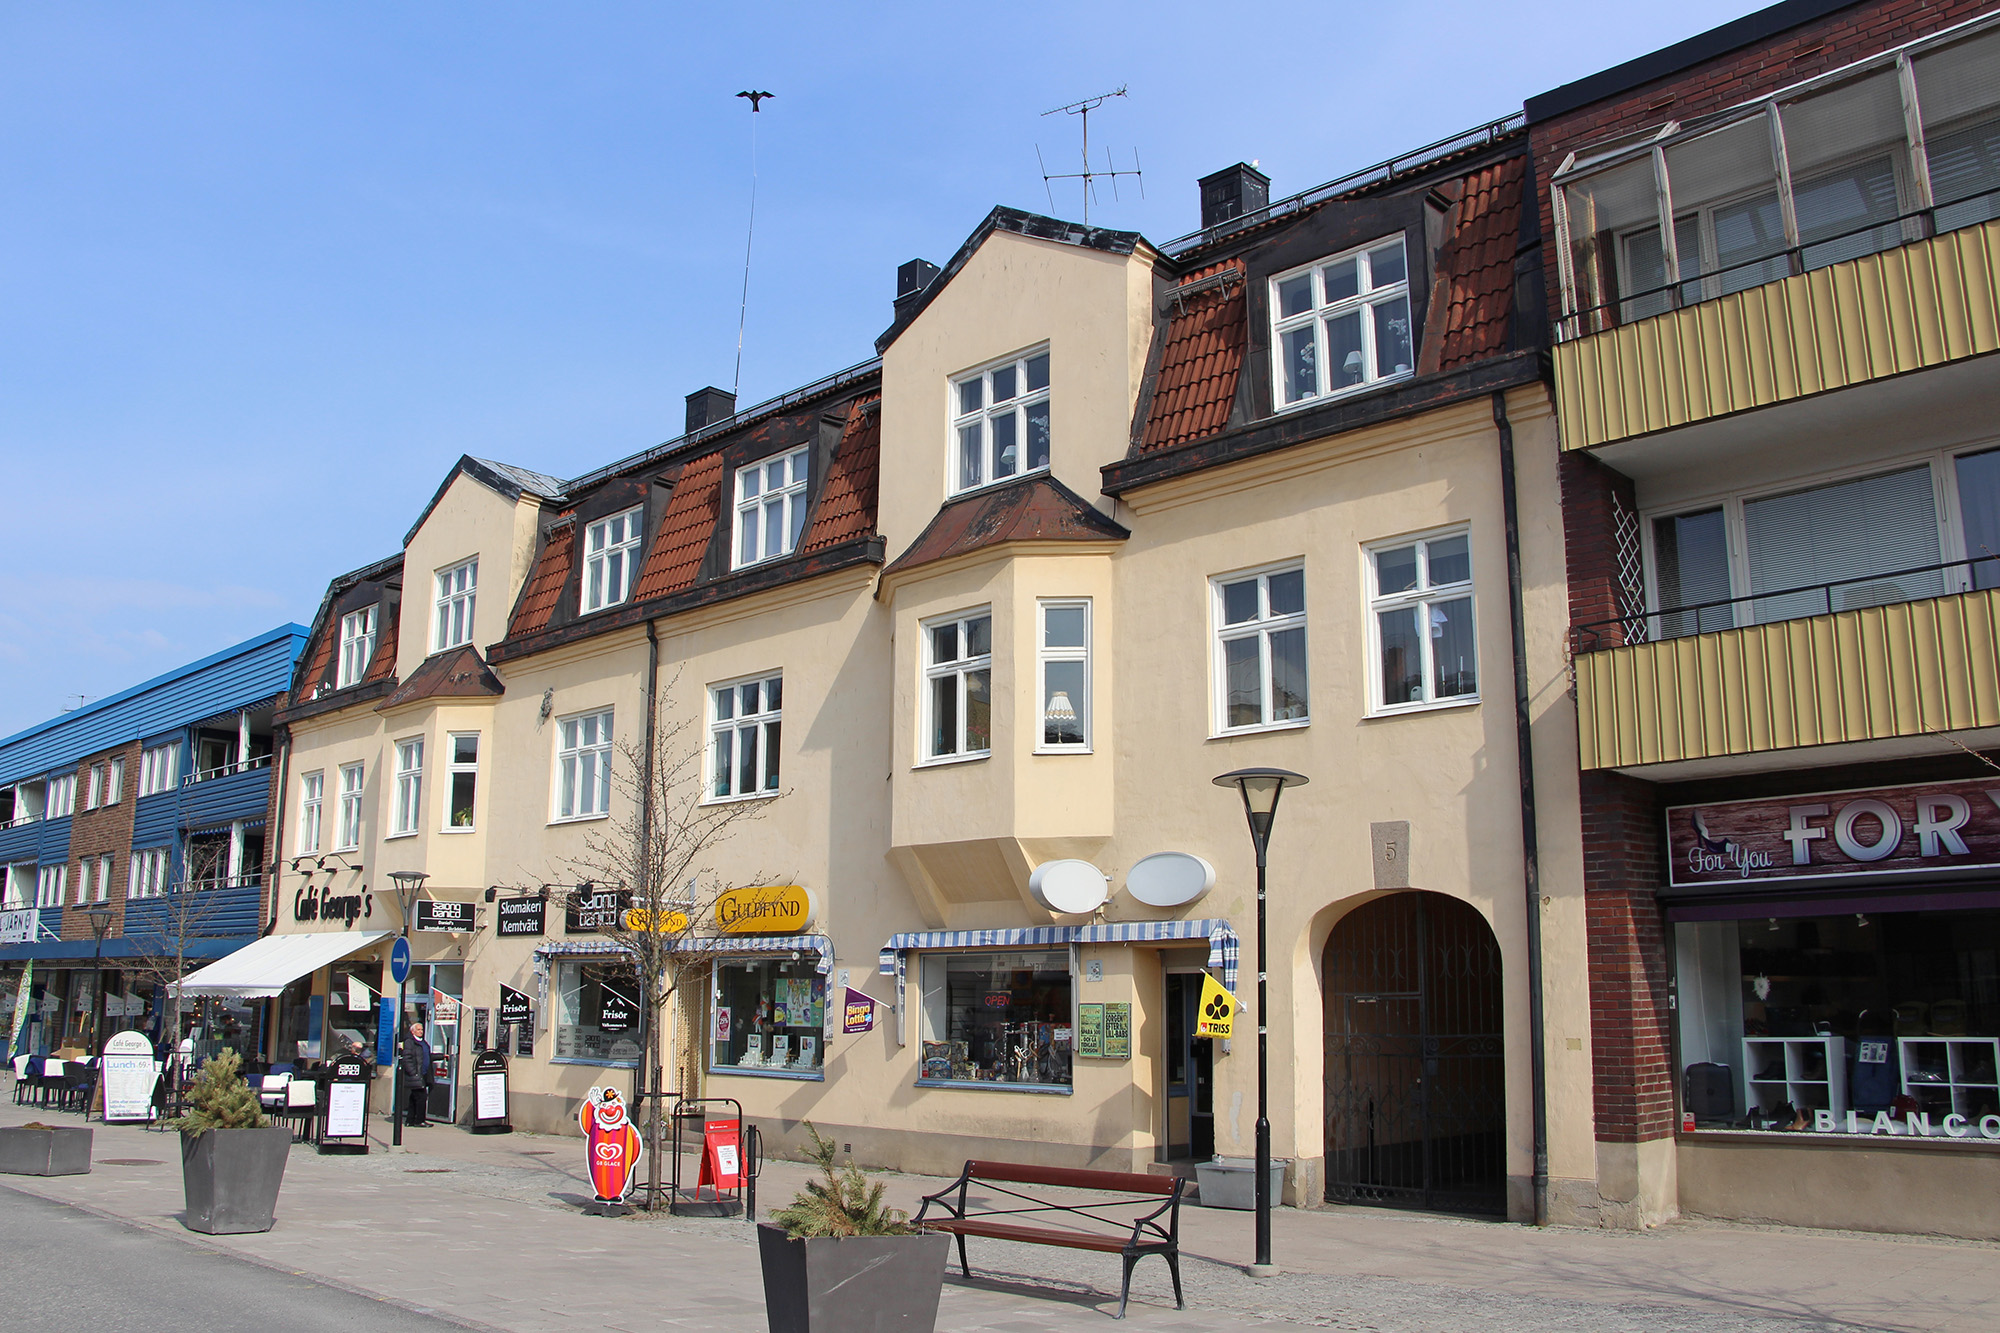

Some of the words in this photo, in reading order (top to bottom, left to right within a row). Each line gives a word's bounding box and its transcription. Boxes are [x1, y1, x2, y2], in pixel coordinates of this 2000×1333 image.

[1783, 793, 1971, 865] FOR
[1385, 841, 1397, 862] 5
[1688, 846, 1726, 874] For
[1729, 842, 1773, 878] You
[294, 885, 319, 921] Café
[501, 900, 542, 915] Skomakeri
[720, 896, 800, 923] GULDFYND
[502, 919, 539, 933] Kemtvätt
[984, 995, 1010, 1006] OPEN
[502, 1004, 528, 1013] Frisör
[602, 1009, 628, 1019] Frisör
[846, 1005, 870, 1016] Bingo
[845, 1014, 865, 1025] Lotto
[1208, 1022, 1230, 1034] TRISS
[107, 1060, 136, 1069] Lunch
[1814, 1108, 2000, 1139] BIANCO
